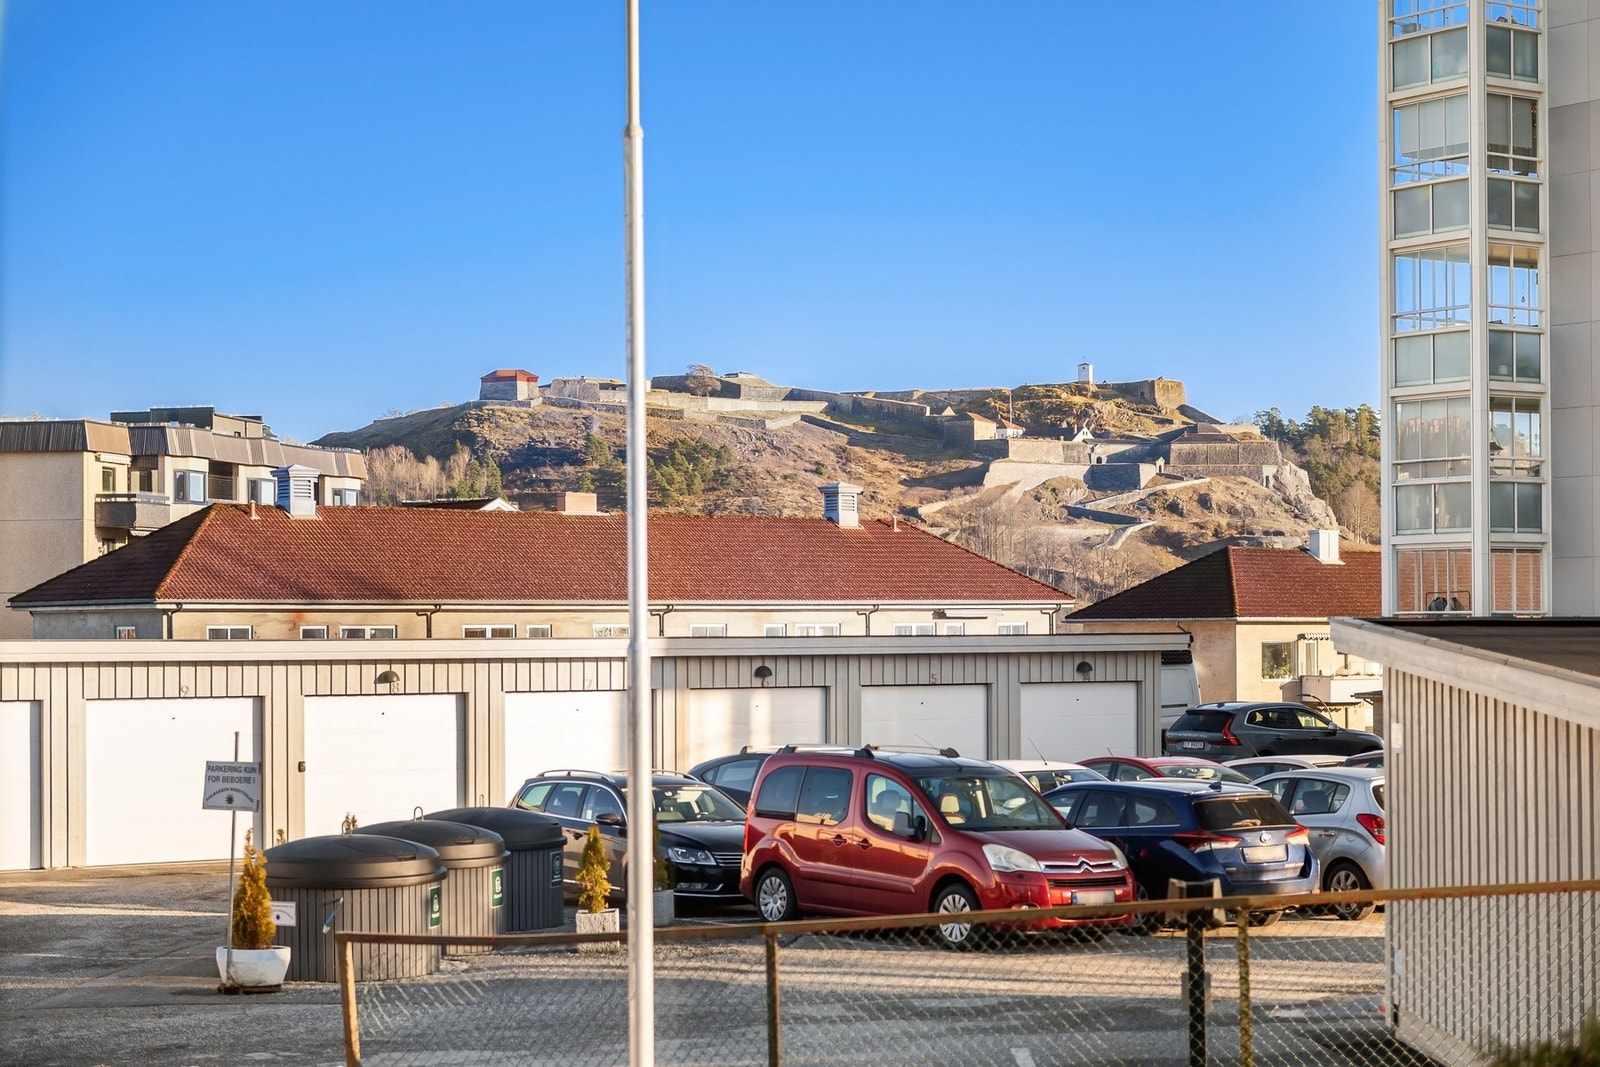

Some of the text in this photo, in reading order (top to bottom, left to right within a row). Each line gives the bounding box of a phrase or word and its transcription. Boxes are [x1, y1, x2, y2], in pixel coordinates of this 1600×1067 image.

[931, 674, 937, 684] 5
[181, 685, 190, 697] 9
[222, 776, 252, 784] BEBOERE
